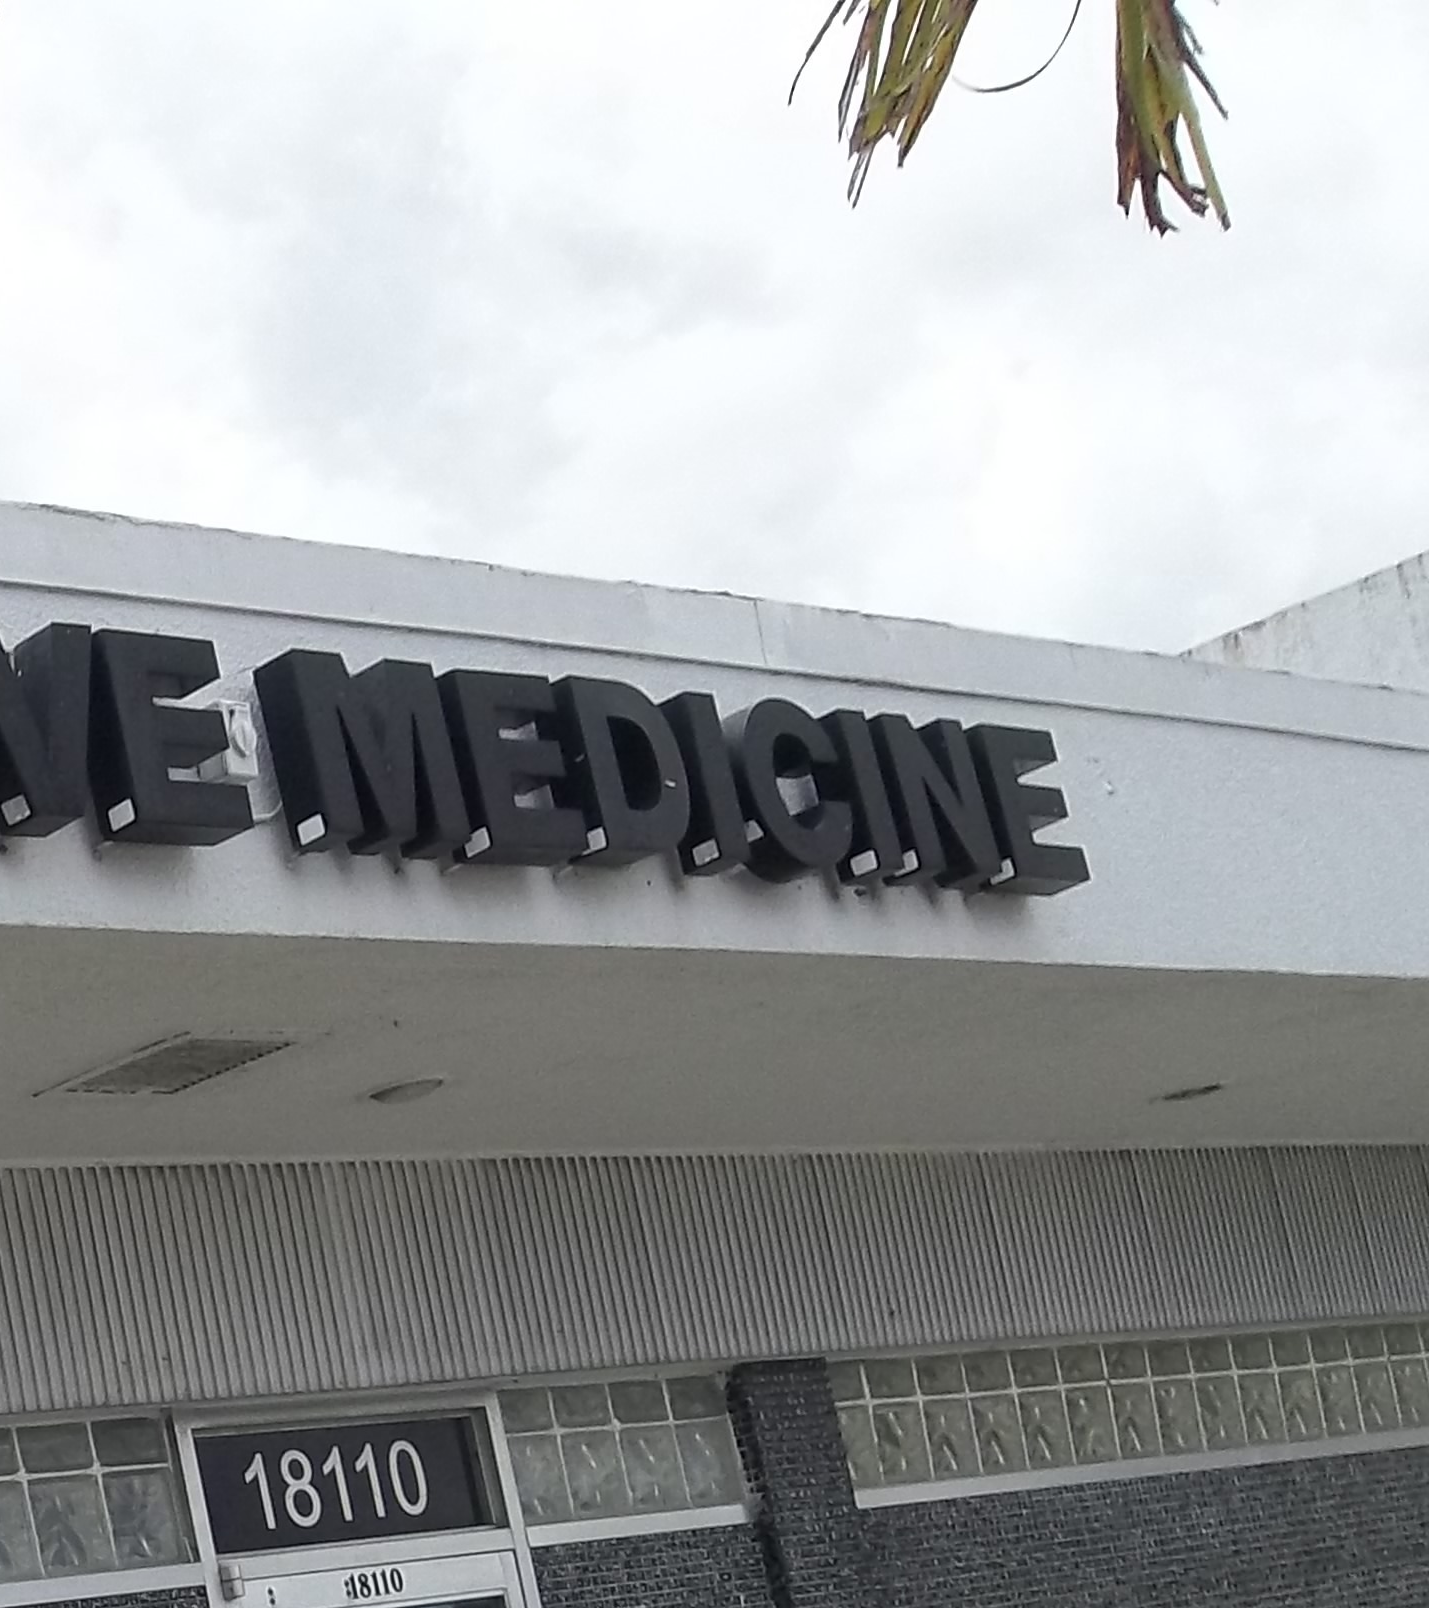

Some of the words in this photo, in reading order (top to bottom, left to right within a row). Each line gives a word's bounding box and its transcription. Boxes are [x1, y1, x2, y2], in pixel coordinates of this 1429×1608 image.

[253, 648, 1090, 896] MEDICINE
[243, 1439, 429, 1530] 18110
[348, 1567, 404, 1600] 18110
